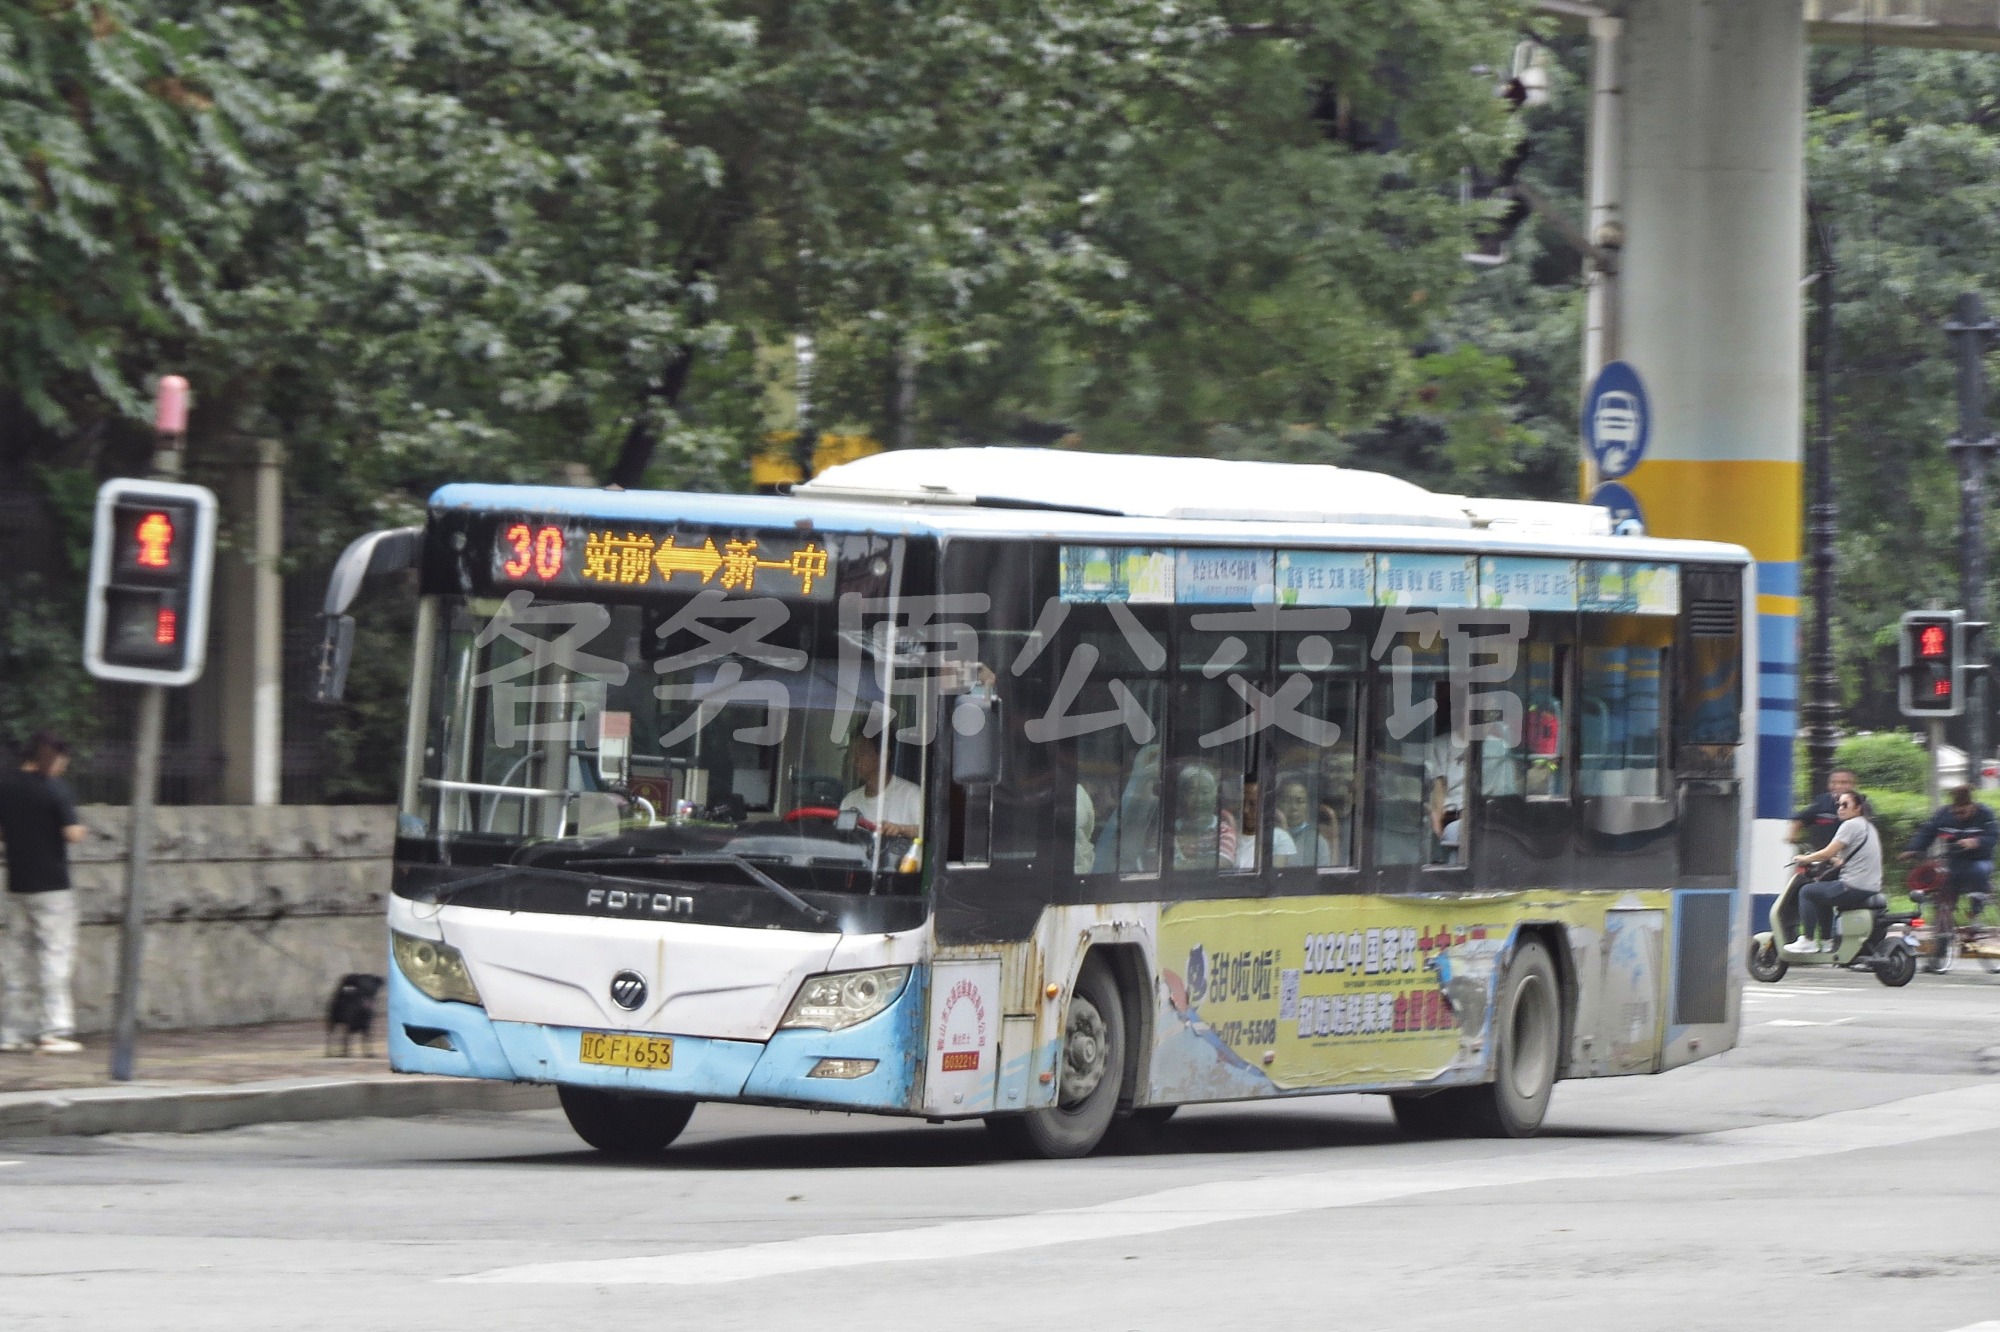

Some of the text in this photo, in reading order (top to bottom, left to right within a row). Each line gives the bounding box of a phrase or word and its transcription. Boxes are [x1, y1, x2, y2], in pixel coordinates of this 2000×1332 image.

[504, 525, 565, 580] 30
[582, 530, 829, 595] 站前 新一中
[586, 889, 694, 914] FOTON
[1209, 950, 1273, 1003] 甜啦啦
